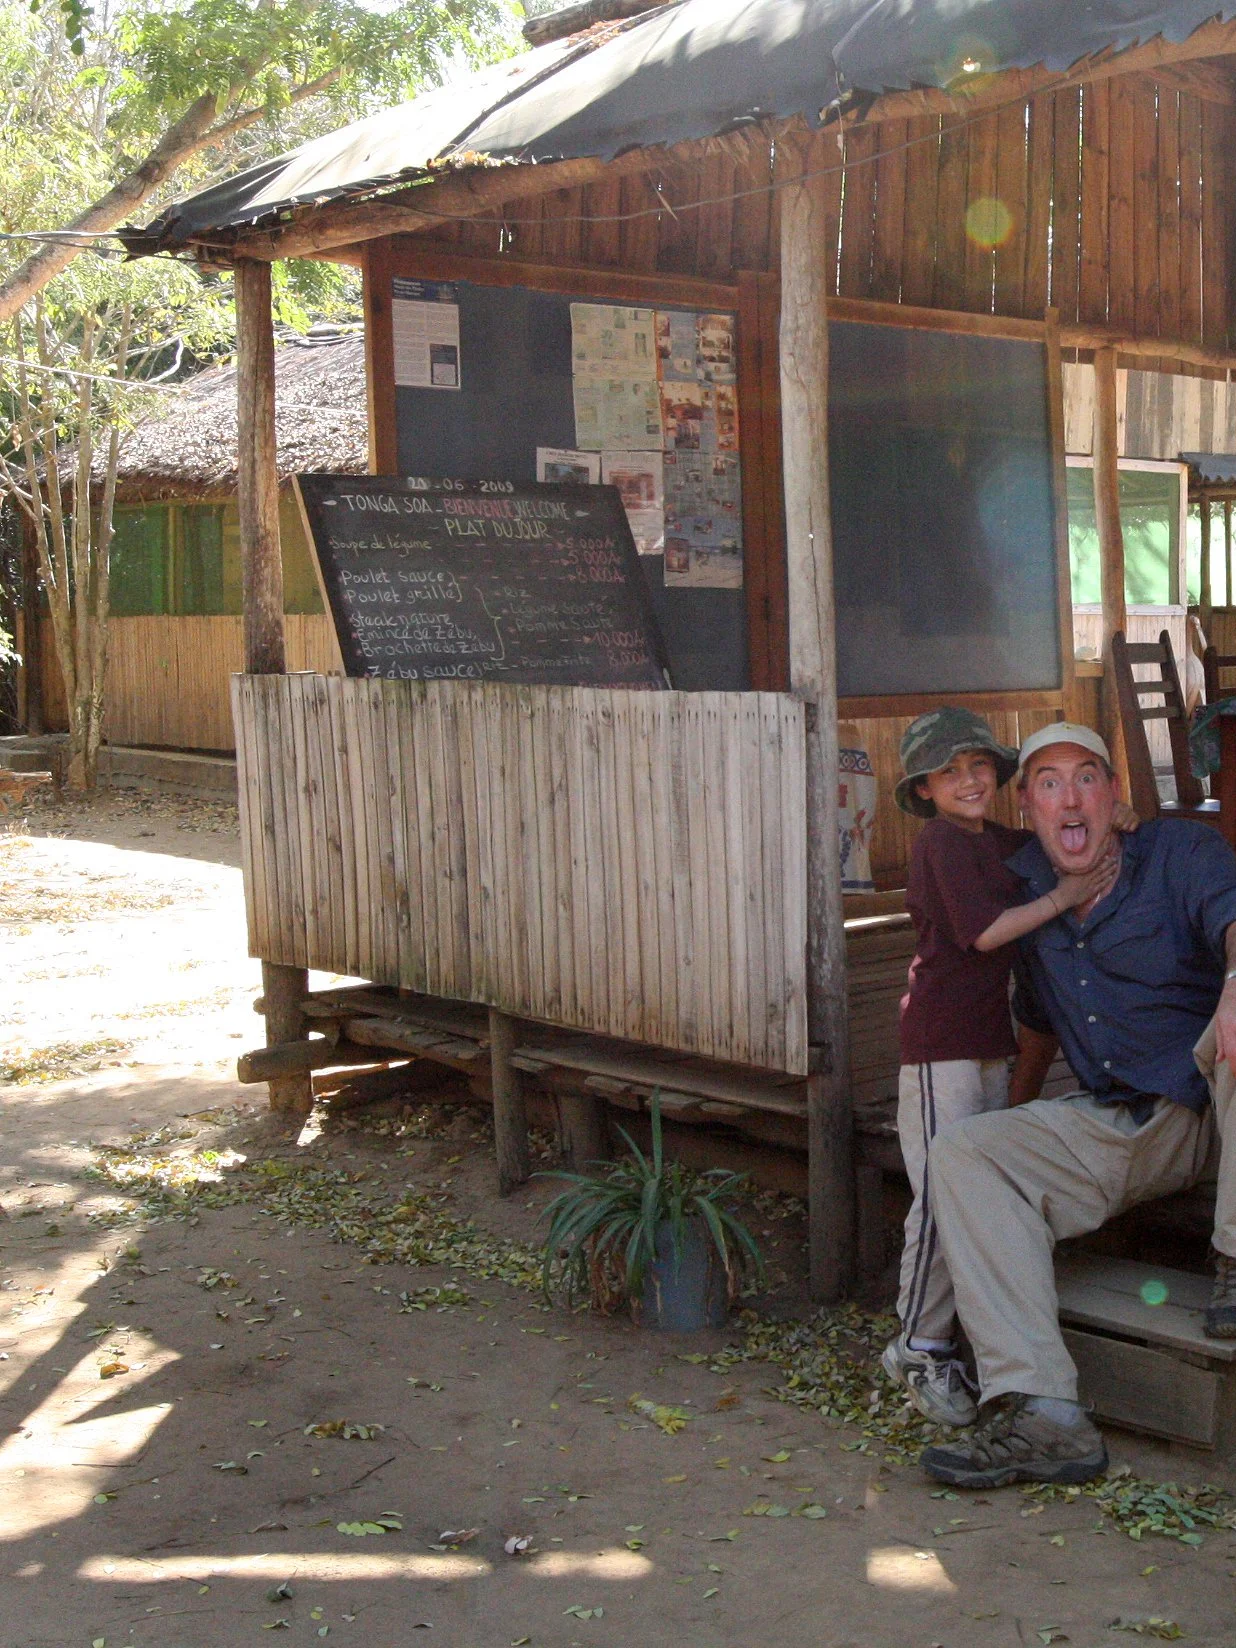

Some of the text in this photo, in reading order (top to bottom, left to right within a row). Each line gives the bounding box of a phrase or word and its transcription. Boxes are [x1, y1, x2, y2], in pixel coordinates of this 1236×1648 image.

[340, 494, 400, 515] TONGA
[404, 497, 434, 514] SOA
[444, 518, 553, 540] PLAT DU JOUR
[341, 568, 391, 586] Poulet
[346, 586, 401, 604] Poulet
